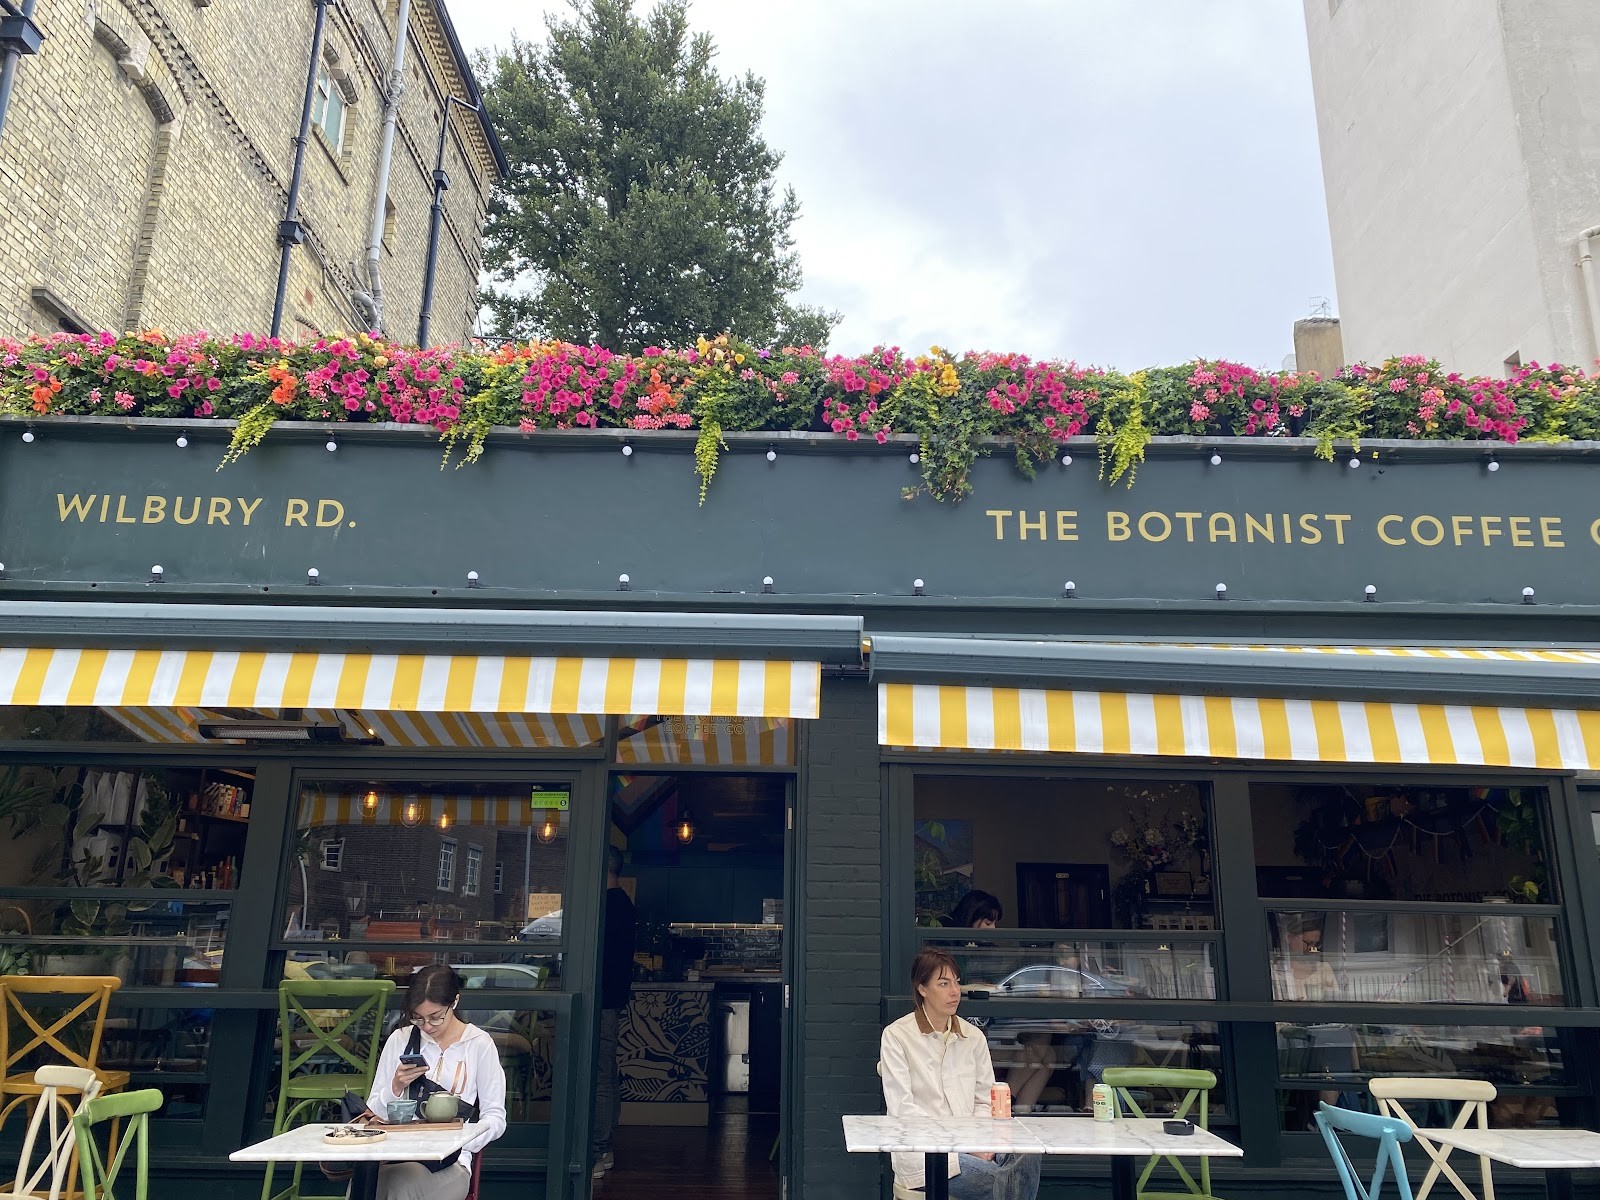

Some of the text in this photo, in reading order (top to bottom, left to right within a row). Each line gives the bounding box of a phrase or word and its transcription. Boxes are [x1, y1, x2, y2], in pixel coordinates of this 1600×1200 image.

[57, 493, 356, 528] WILBURY RD.
[986, 510, 1078, 541] THE
[1107, 511, 1351, 545] BOTANIST
[1377, 514, 1565, 547] COFFEE
[664, 723, 718, 734] COFFEE
